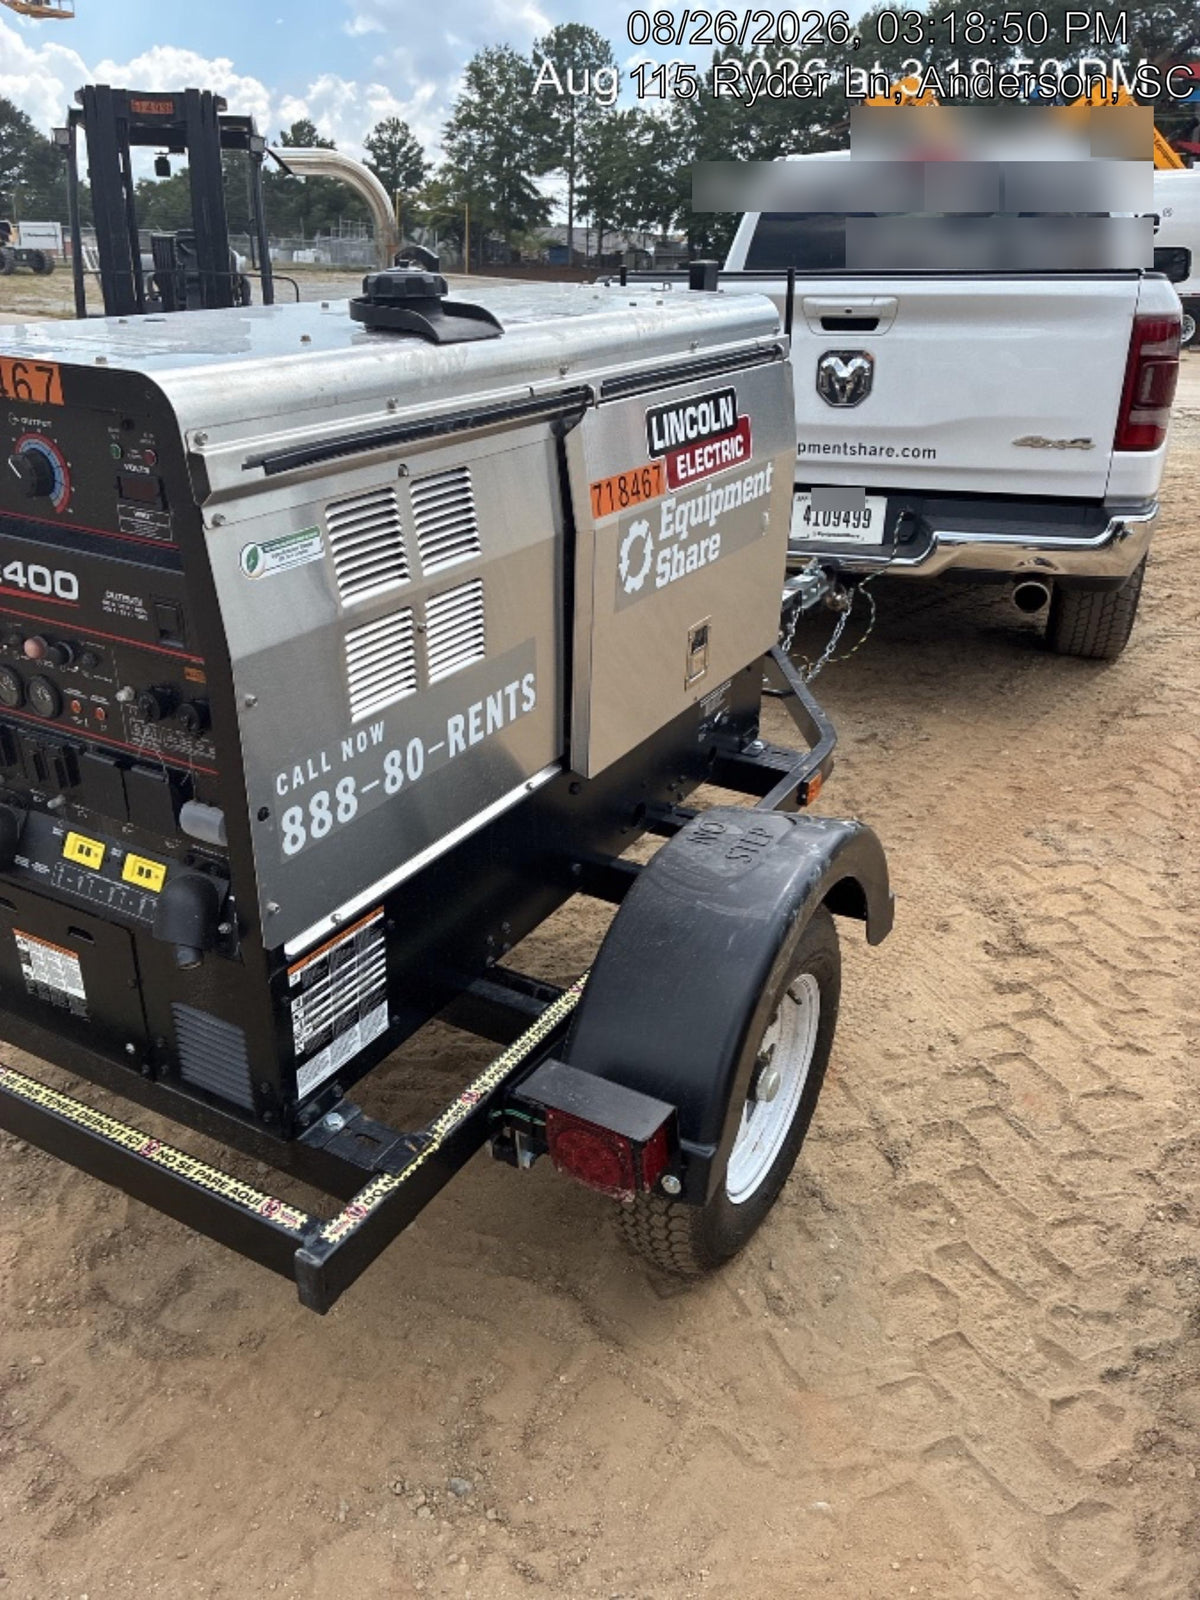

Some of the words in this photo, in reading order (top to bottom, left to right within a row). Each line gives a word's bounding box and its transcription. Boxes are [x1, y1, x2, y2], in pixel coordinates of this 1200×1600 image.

[651, 395, 734, 450] LINCOLN
[677, 434, 744, 480] ELECTRIC
[591, 465, 662, 516] 718467
[659, 462, 774, 541] Equipment
[655, 532, 721, 588] Share
[276, 751, 332, 796] CALL
[341, 720, 385, 761] NOW
[281, 672, 536, 856] 888-80-RENTS
[156, 1149, 177, 1165] NO
[176, 1160, 196, 1175] SE
[194, 1169, 233, 1192] PARE
